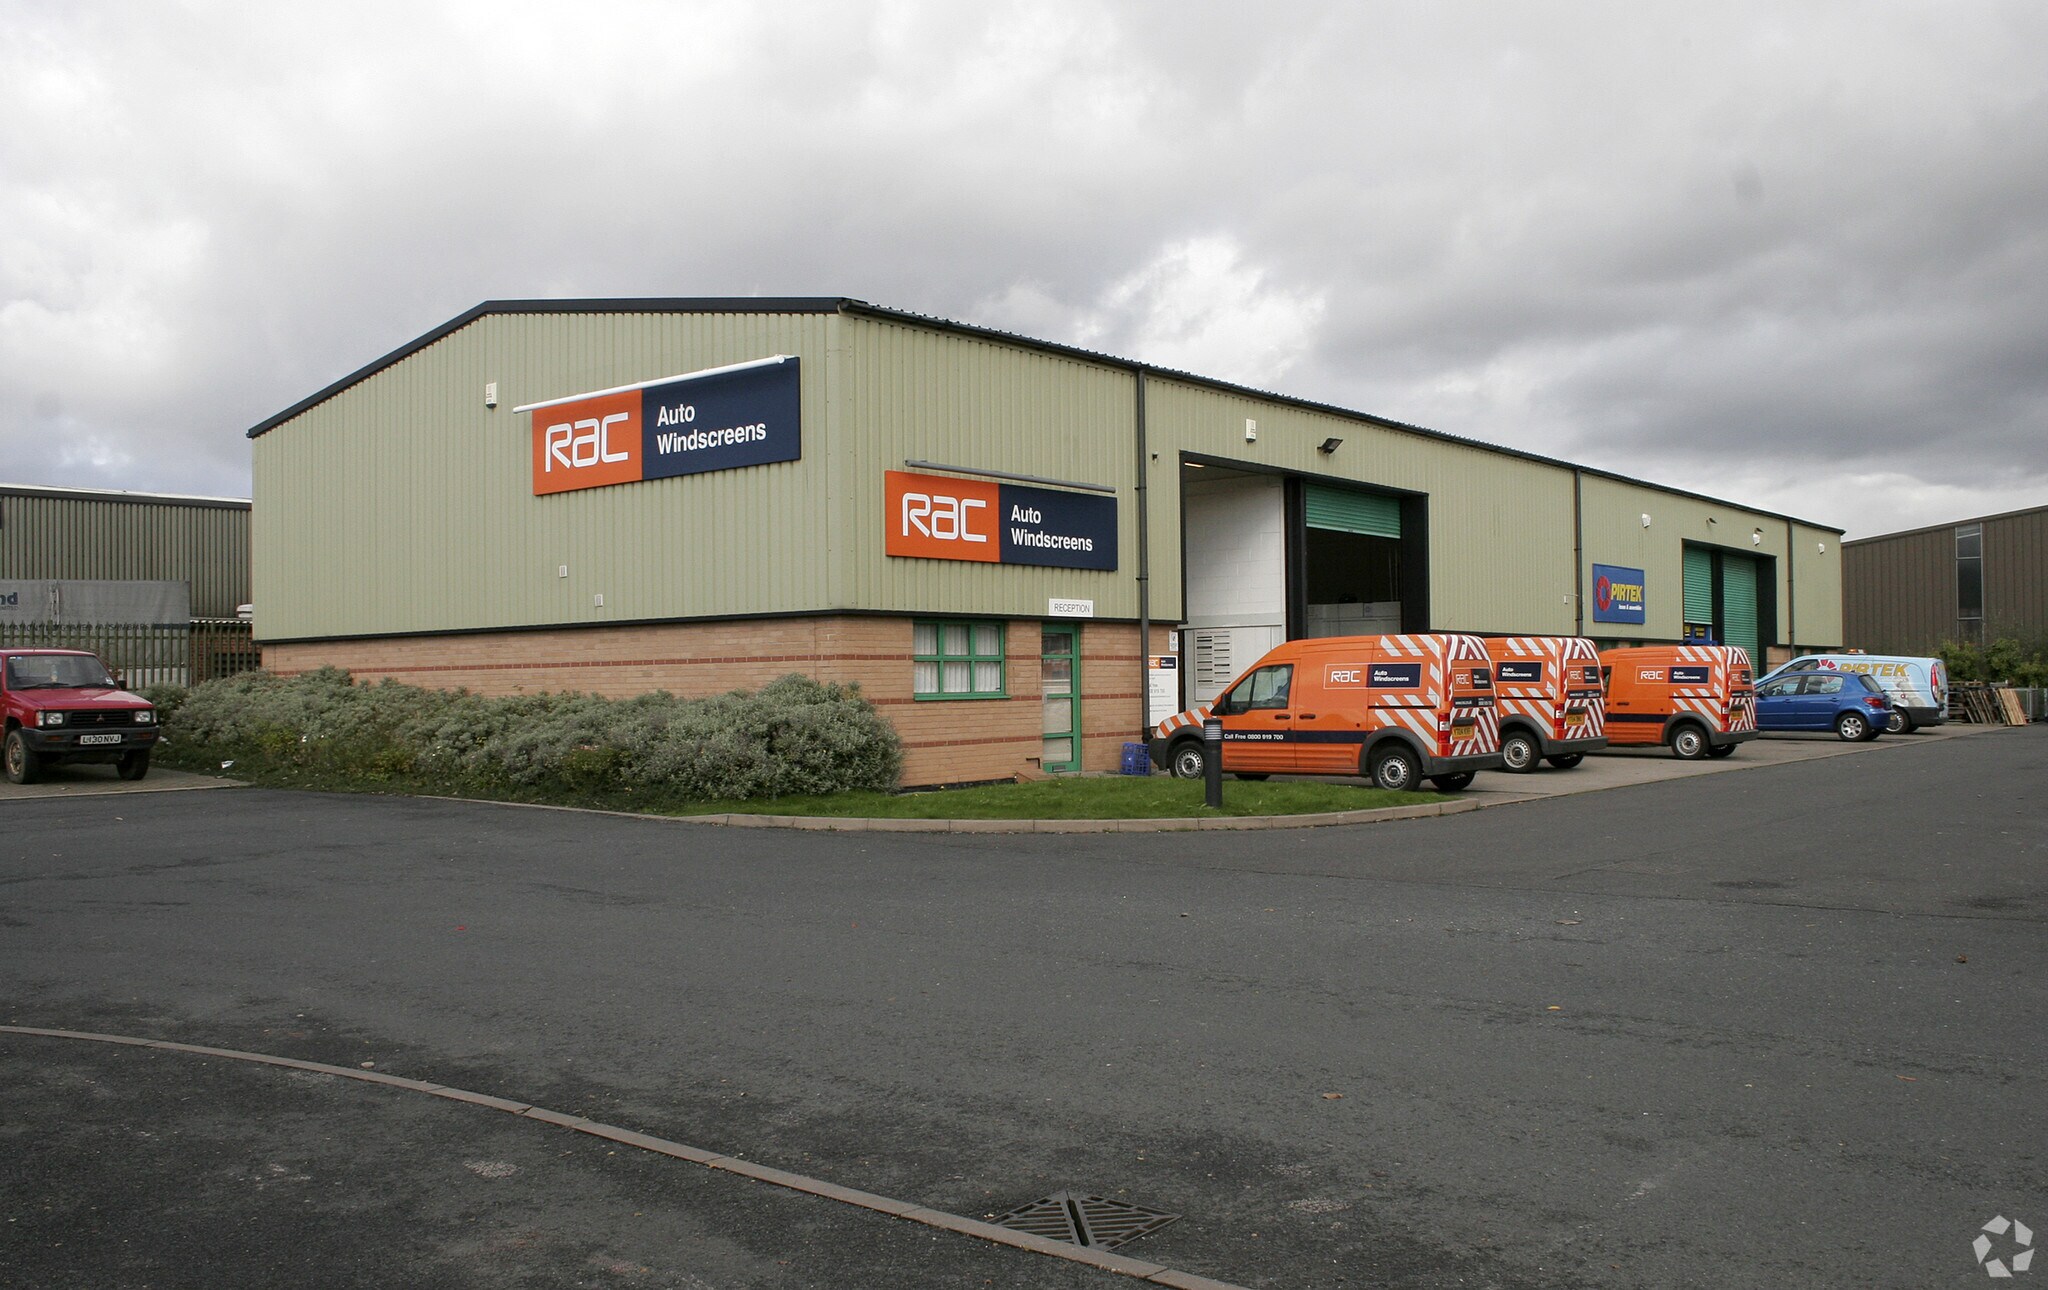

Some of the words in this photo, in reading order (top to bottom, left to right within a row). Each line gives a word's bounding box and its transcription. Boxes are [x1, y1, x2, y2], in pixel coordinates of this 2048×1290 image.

[657, 403, 696, 427] Auto
[656, 422, 767, 455] Windscreens
[1010, 504, 1042, 525] Auto
[1010, 527, 1093, 552] Windscreens
[1610, 583, 1643, 602] PIRTEK
[1054, 602, 1091, 614] RECEPTION
[1224, 733, 1234, 741] Call
[1235, 733, 1246, 741] Free
